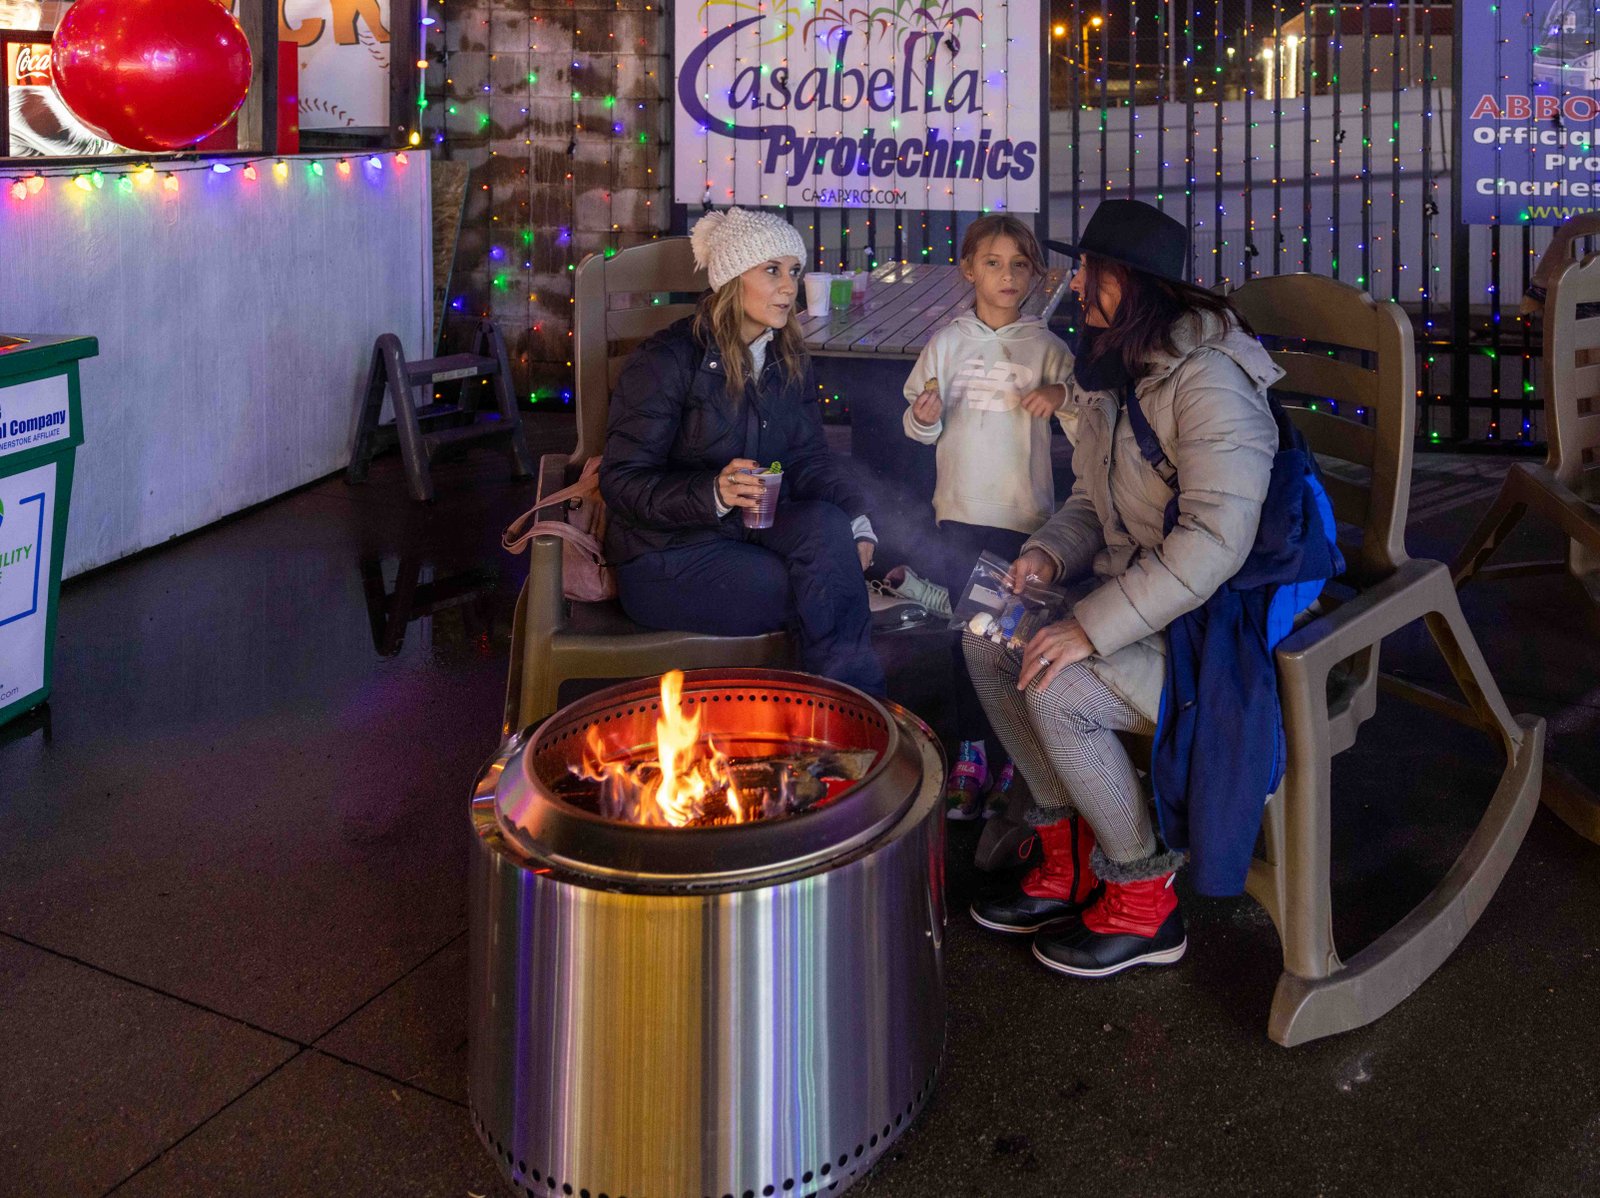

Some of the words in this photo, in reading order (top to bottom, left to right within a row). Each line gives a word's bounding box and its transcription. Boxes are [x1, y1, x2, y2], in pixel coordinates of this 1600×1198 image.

[678, 14, 983, 140] Casabella
[1473, 127, 1600, 145] Official
[764, 125, 1037, 186] Pyrotechnics
[802, 188, 906, 205] CASAPYRO.COM
[10, 410, 66, 437] Company
[33, 428, 60, 442] AFFILIATE
